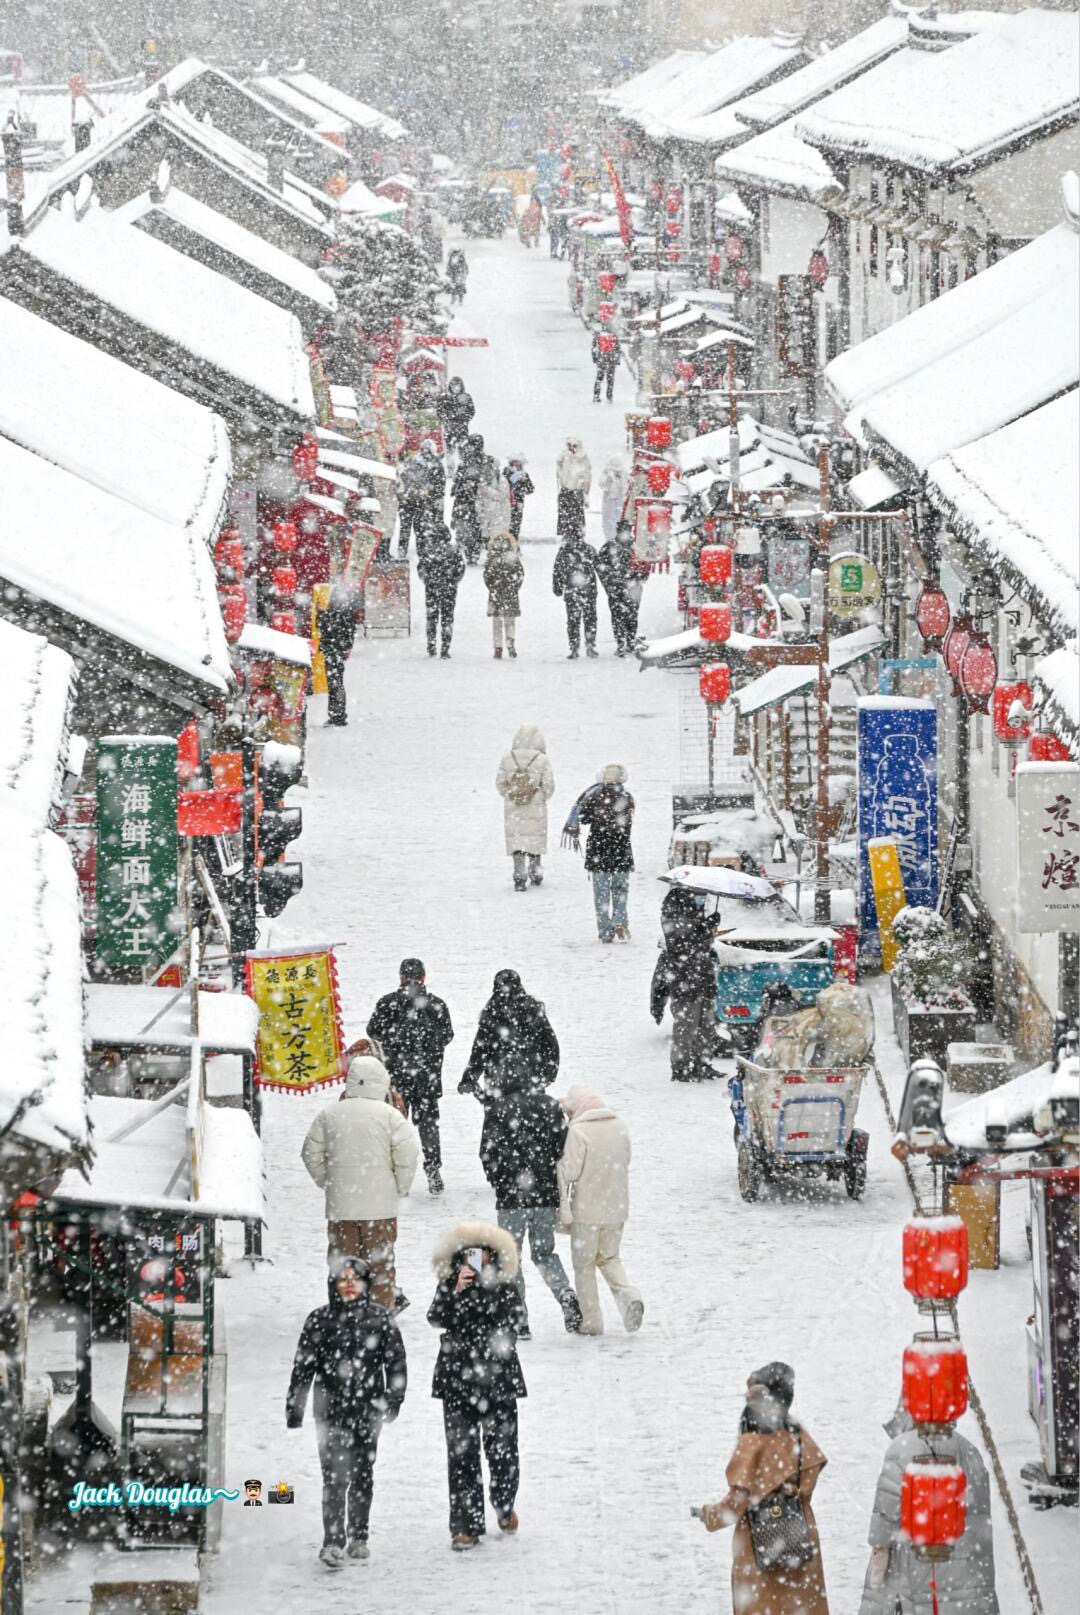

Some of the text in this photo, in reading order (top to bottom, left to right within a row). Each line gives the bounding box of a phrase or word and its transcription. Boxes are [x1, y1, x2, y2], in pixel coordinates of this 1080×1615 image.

[120, 783, 153, 956] 海鲜面大王
[278, 992, 318, 1082] 古方茶
